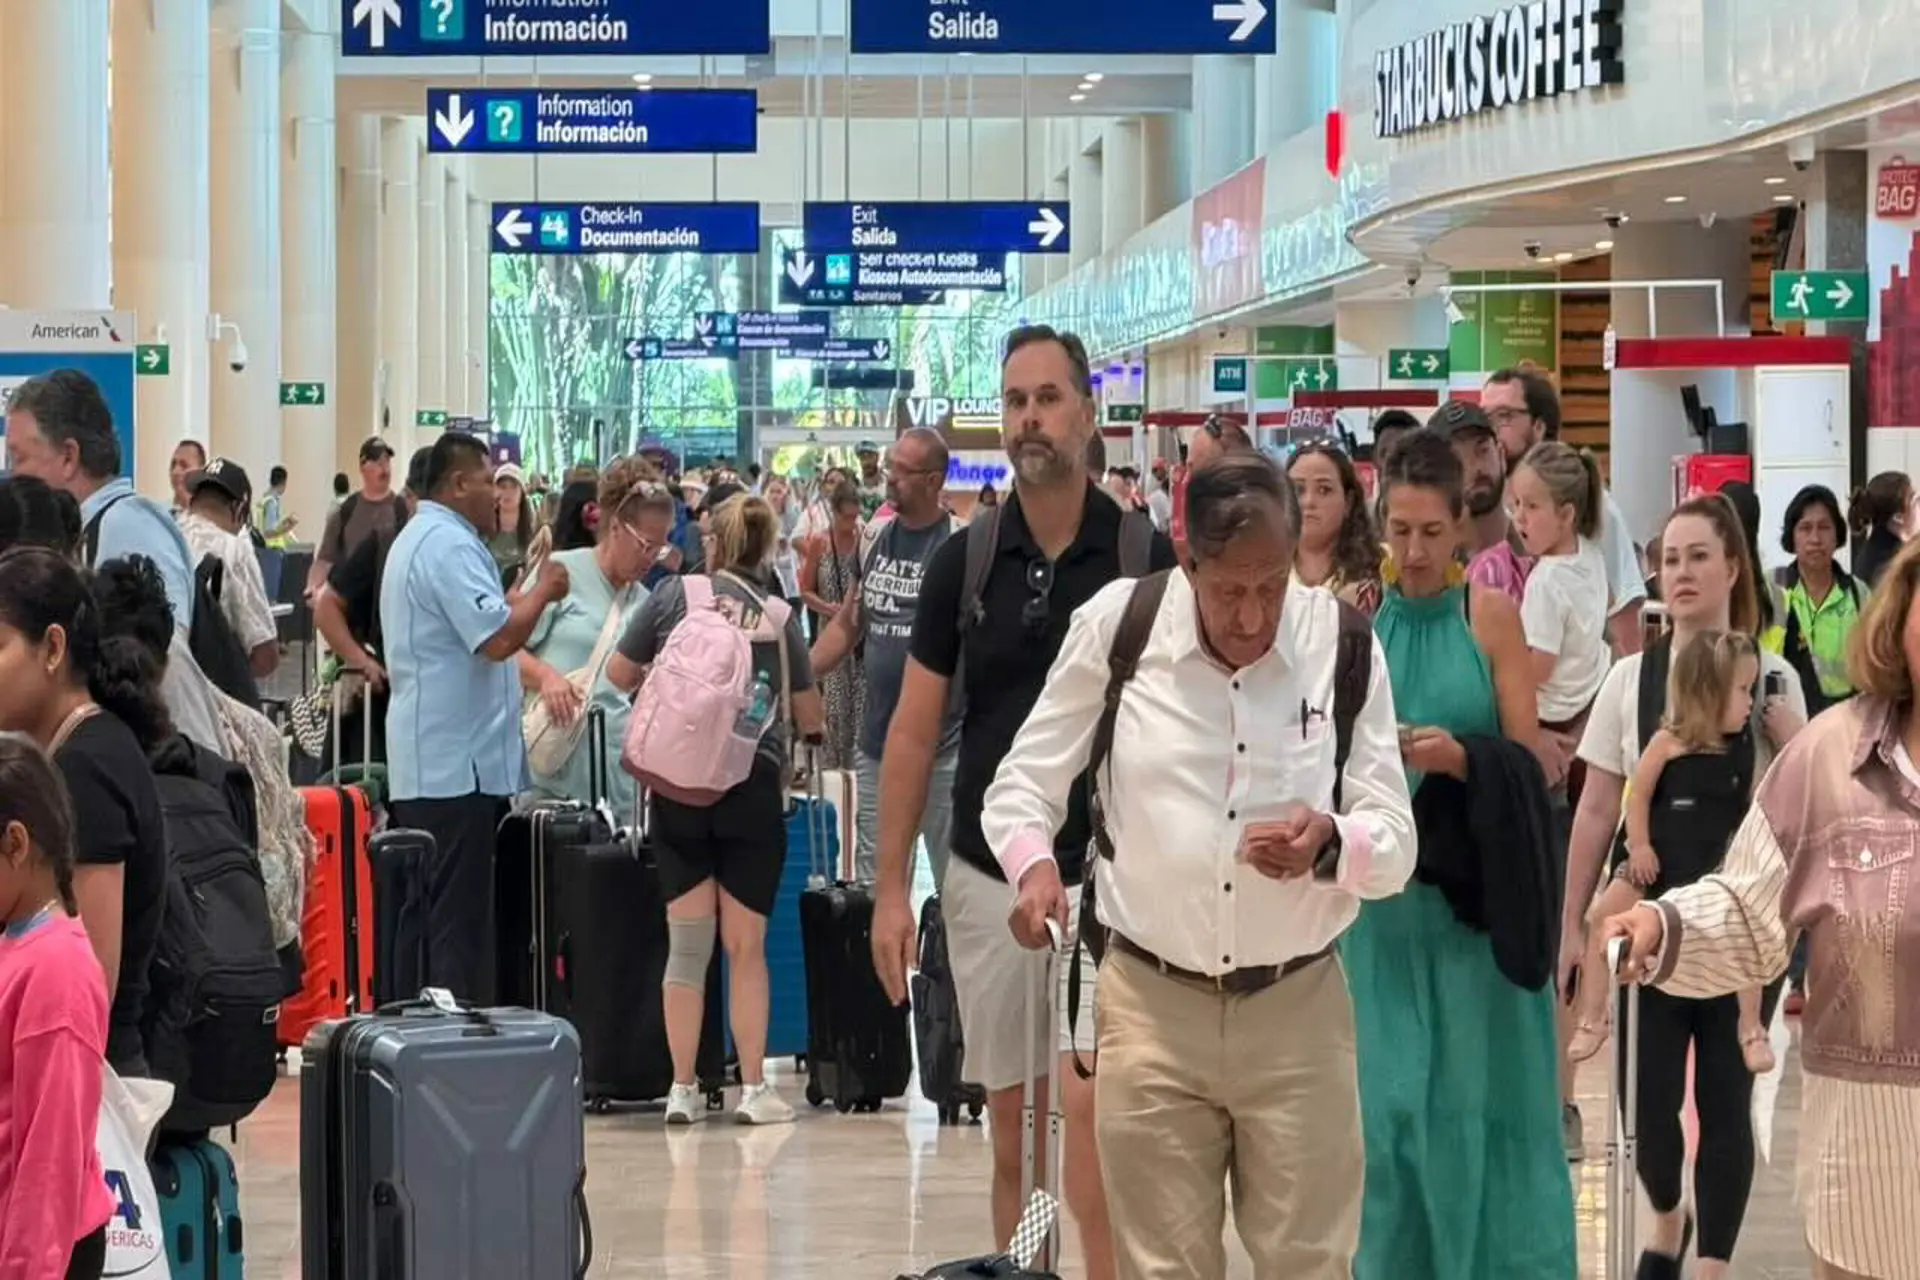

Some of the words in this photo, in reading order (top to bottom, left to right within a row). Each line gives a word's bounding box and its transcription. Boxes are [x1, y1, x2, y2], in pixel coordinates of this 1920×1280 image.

[485, 13, 628, 41] Información
[929, 11, 999, 39] Salida
[1374, 16, 1485, 138] STARBUCKS
[1489, 0, 1602, 107] COFFEE
[537, 93, 633, 116] Information
[537, 120, 648, 143] Información
[1878, 186, 1916, 212] BAG
[852, 205, 877, 224] Exit
[581, 227, 699, 246] Documentación
[852, 227, 897, 245] Salida
[32, 323, 99, 339] American
[906, 398, 949, 426] VIP
[953, 398, 1002, 414] LOUNG
[891, 625, 912, 636] TIM
[107, 1231, 155, 1250] ERICAS
